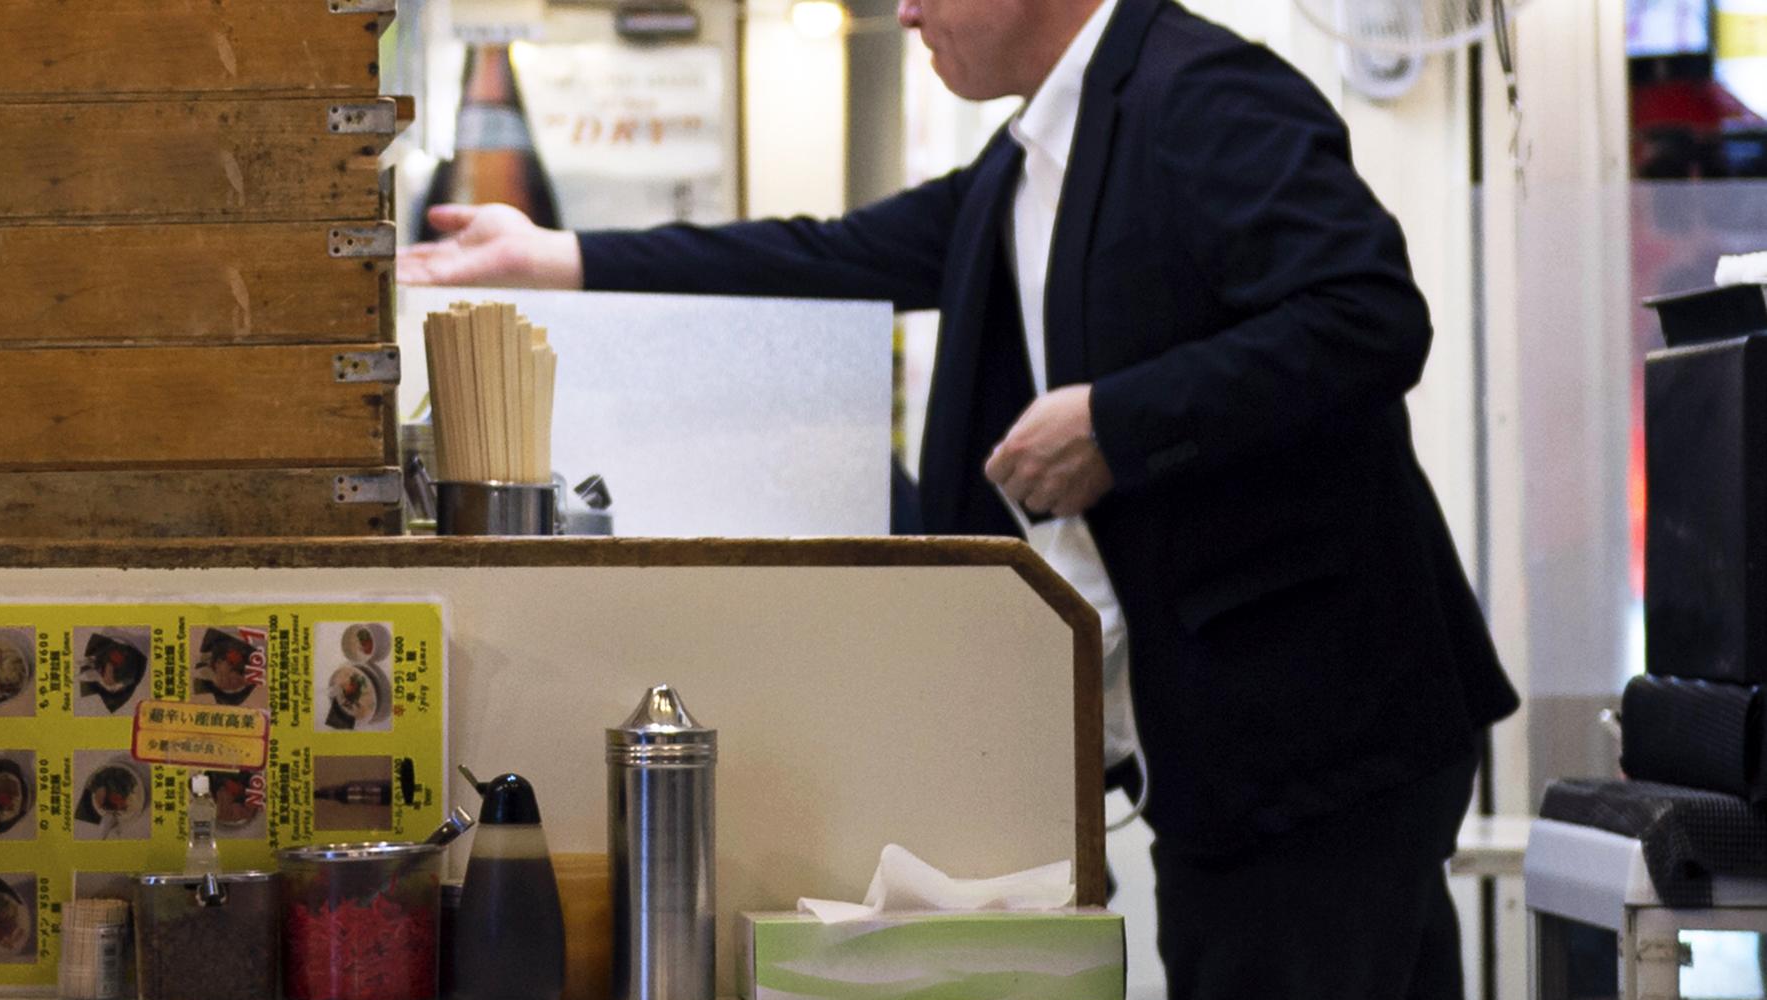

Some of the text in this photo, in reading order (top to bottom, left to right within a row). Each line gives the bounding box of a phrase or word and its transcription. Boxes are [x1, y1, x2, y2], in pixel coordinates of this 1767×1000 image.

[238, 627, 267, 685] No.1
[154, 765, 164, 789] ¥65
[245, 770, 266, 808] No.
